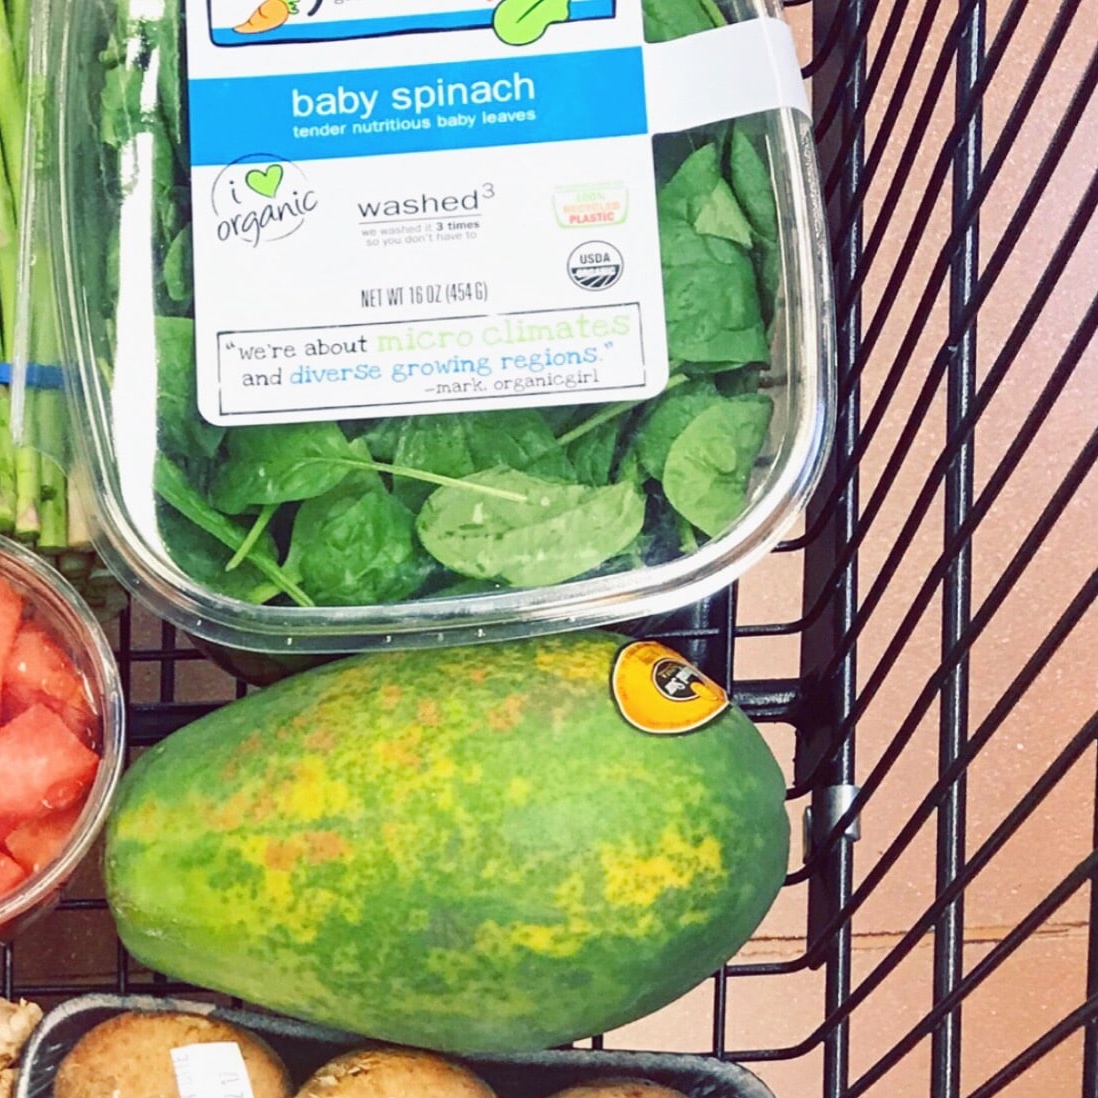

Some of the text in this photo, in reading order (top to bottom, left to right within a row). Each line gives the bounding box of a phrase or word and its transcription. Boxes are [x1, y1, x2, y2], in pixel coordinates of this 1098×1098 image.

[292, 72, 536, 121] baby spinach
[292, 108, 536, 139] tender nutritious baby leaves
[229, 180, 242, 204] i
[217, 189, 319, 248] organic
[361, 228, 376, 237] we
[380, 223, 422, 236] washed
[436, 221, 444, 232] 3
[447, 219, 480, 232] times
[569, 212, 615, 224] PLASTIC
[366, 230, 477, 247] so you don't have to
[579, 252, 611, 264] USDA
[360, 281, 489, 308] NET WT 16 OZ (454 G)
[304, 335, 368, 356] about
[377, 326, 473, 352] micro
[483, 312, 631, 346] climates
[241, 366, 283, 387] and
[290, 362, 381, 385] diverse
[391, 355, 493, 383] growing
[493, 369, 600, 392] organicgirl
